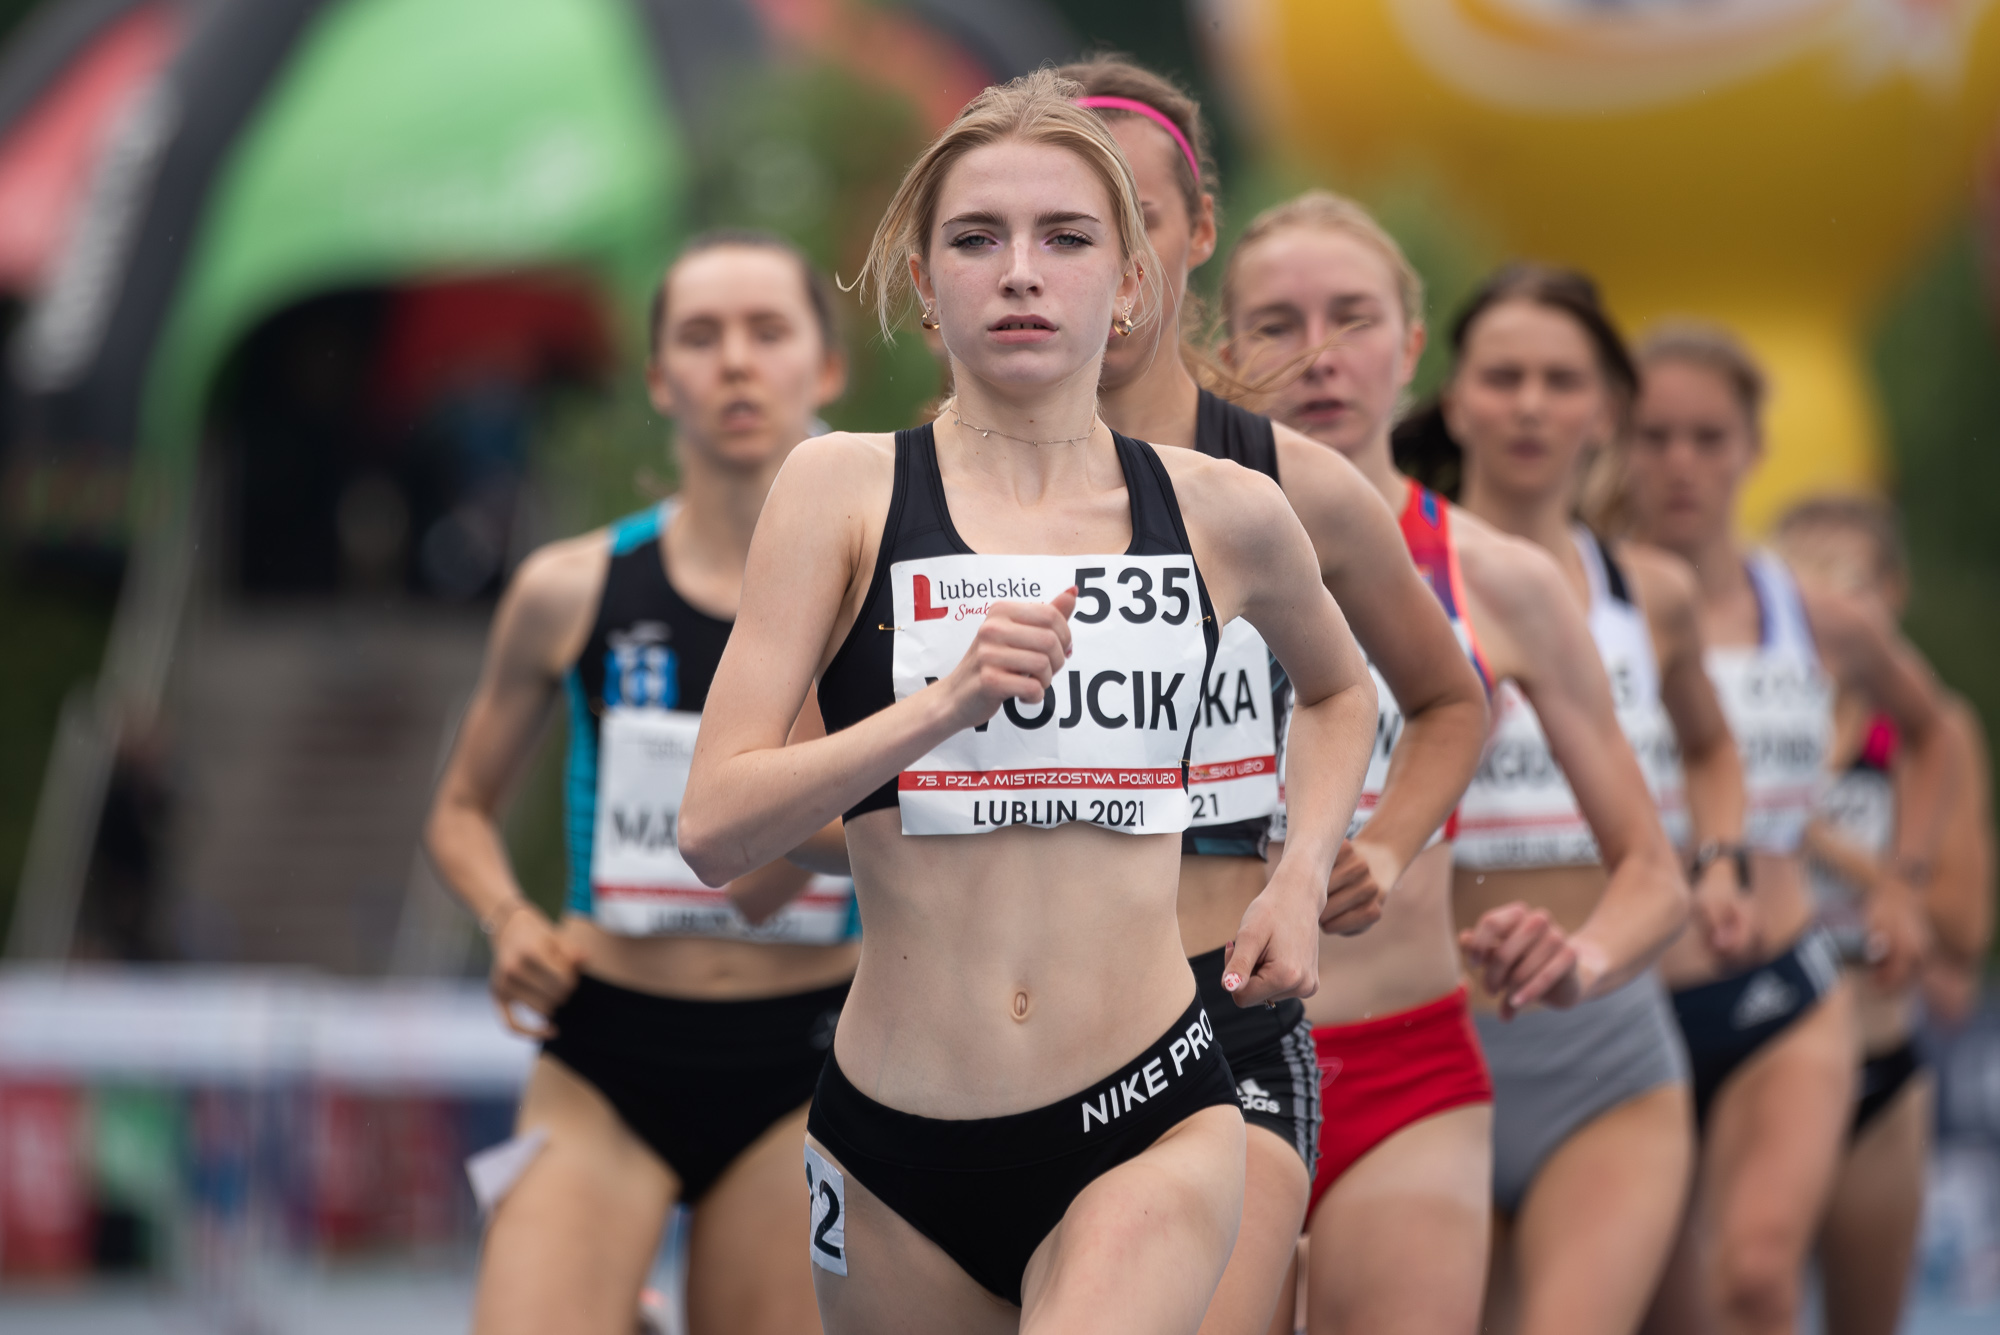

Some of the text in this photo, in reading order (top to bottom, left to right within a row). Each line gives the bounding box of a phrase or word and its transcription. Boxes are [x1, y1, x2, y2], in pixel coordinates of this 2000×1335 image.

[1073, 567, 1191, 626] 535
[924, 670, 1186, 733] OJCIK
[1194, 669, 1258, 730] KA
[945, 775, 990, 787] PZLA
[993, 773, 1116, 787] MISTRZOSTWA
[1118, 773, 1154, 785] POLSKI
[1155, 774, 1176, 785] U20
[973, 800, 1145, 827] LUBLIN 2021
[1081, 1008, 1214, 1134] NIKE PRO
